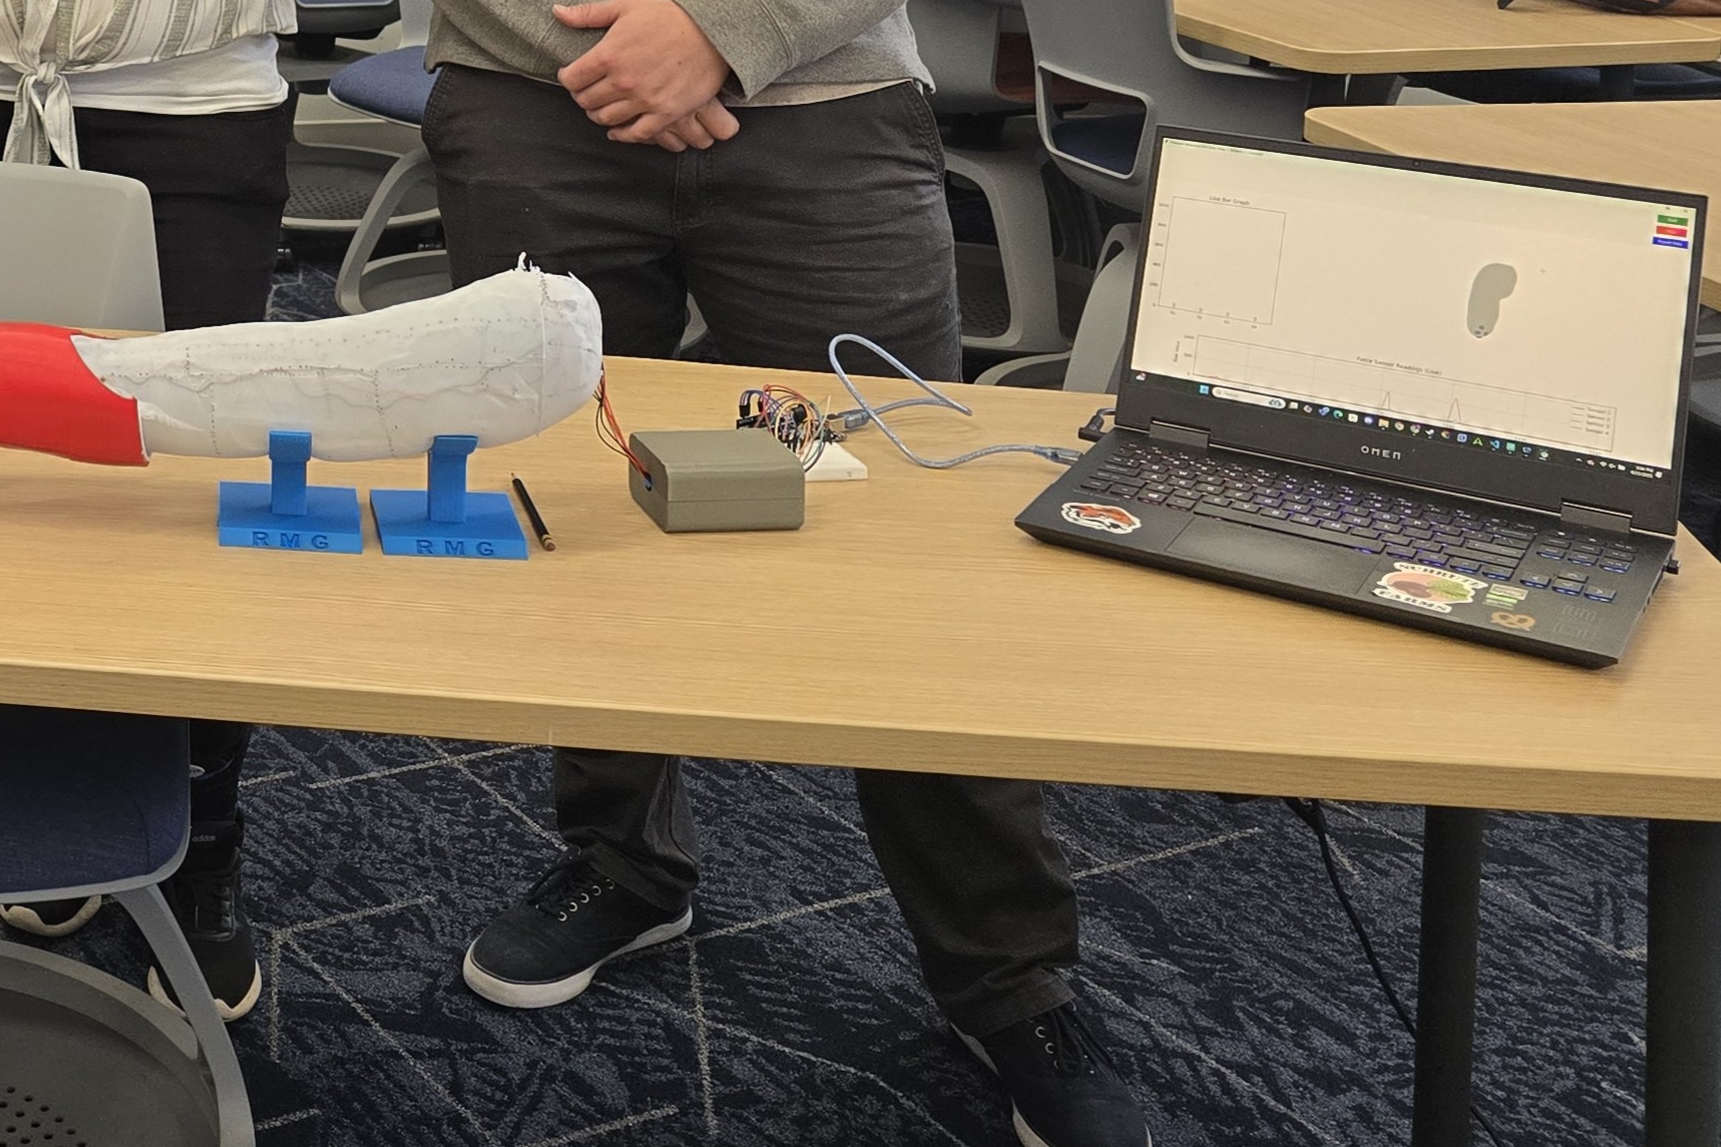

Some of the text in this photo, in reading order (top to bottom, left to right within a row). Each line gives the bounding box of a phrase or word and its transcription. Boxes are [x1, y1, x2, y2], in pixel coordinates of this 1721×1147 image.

[1360, 445, 1402, 461] OMEN
[251, 531, 329, 549] RMG
[415, 539, 495, 557] RMG
